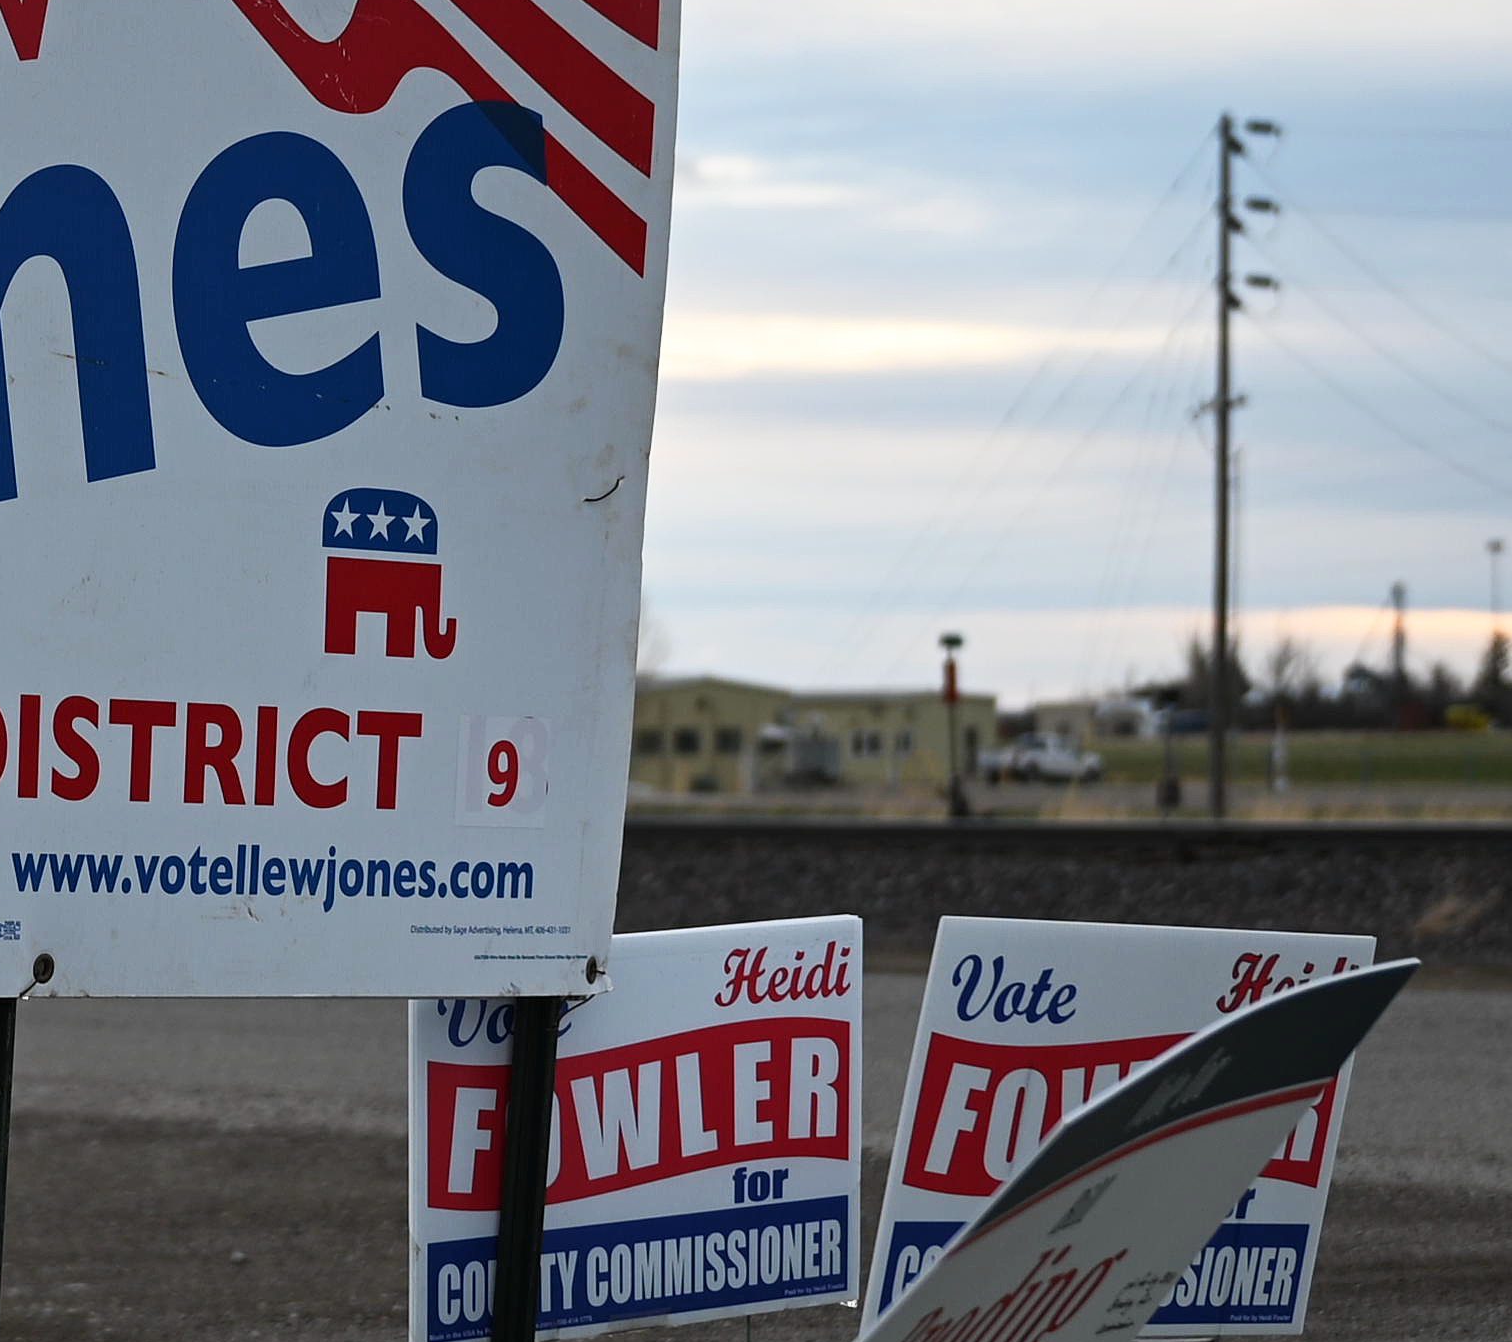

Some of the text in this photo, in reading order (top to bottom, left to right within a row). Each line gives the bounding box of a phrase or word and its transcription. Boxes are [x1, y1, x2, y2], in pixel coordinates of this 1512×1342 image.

[487, 739, 519, 807] 9
[12, 844, 534, 913] www.votellewjones.com
[410, 925, 443, 934] Distributed
[714, 941, 851, 1006] Heidi
[952, 954, 1077, 1025] Vote
[448, 1037, 839, 1194] FWLER
[733, 1167, 789, 1204] for
[586, 1219, 841, 1306] COMMISSIONER
